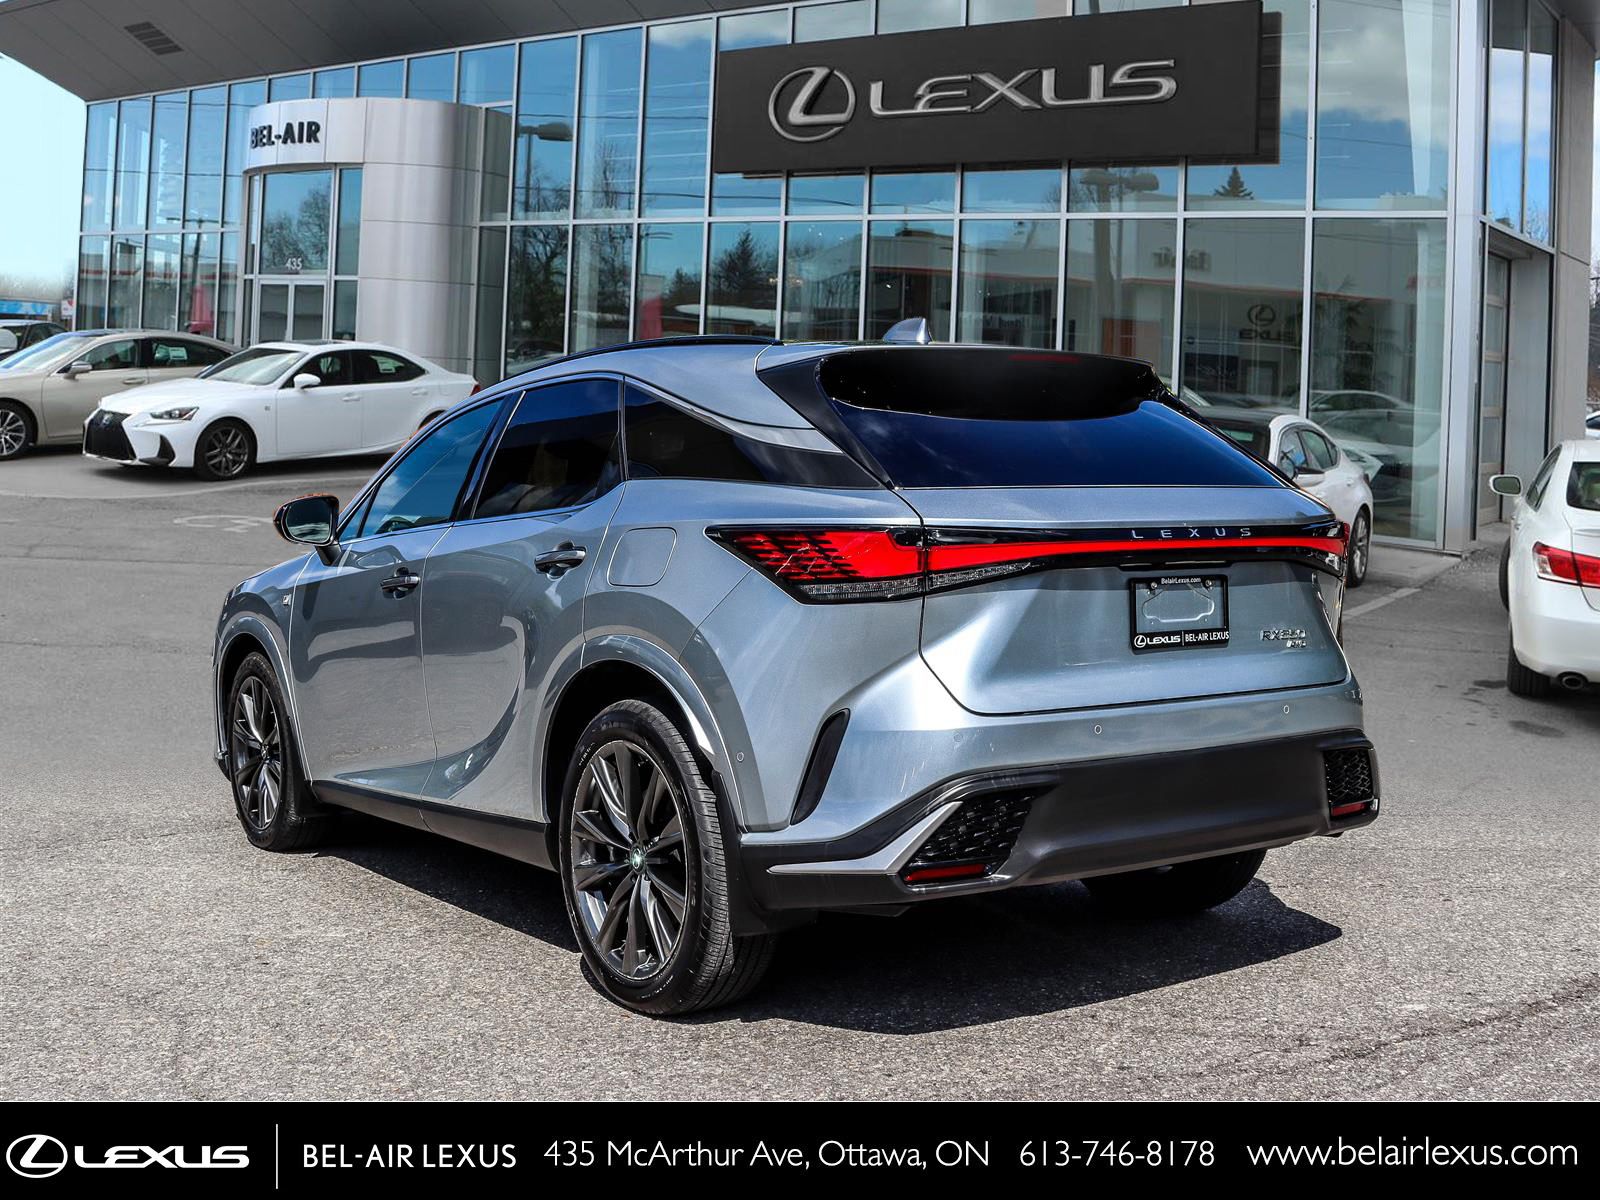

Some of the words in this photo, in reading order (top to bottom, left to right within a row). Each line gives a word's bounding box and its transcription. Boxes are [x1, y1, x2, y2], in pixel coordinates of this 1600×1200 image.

[869, 59, 1177, 118] LEXUS
[250, 120, 321, 149] BEL-AIR
[285, 257, 303, 270] 435
[1131, 527, 1252, 539] LEXUS
[1160, 577, 1202, 585] BelairLexus.com
[1147, 635, 1181, 645] LEXUS
[1184, 632, 1209, 643] BEL-AIR
[1209, 630, 1230, 641] LEXUS
